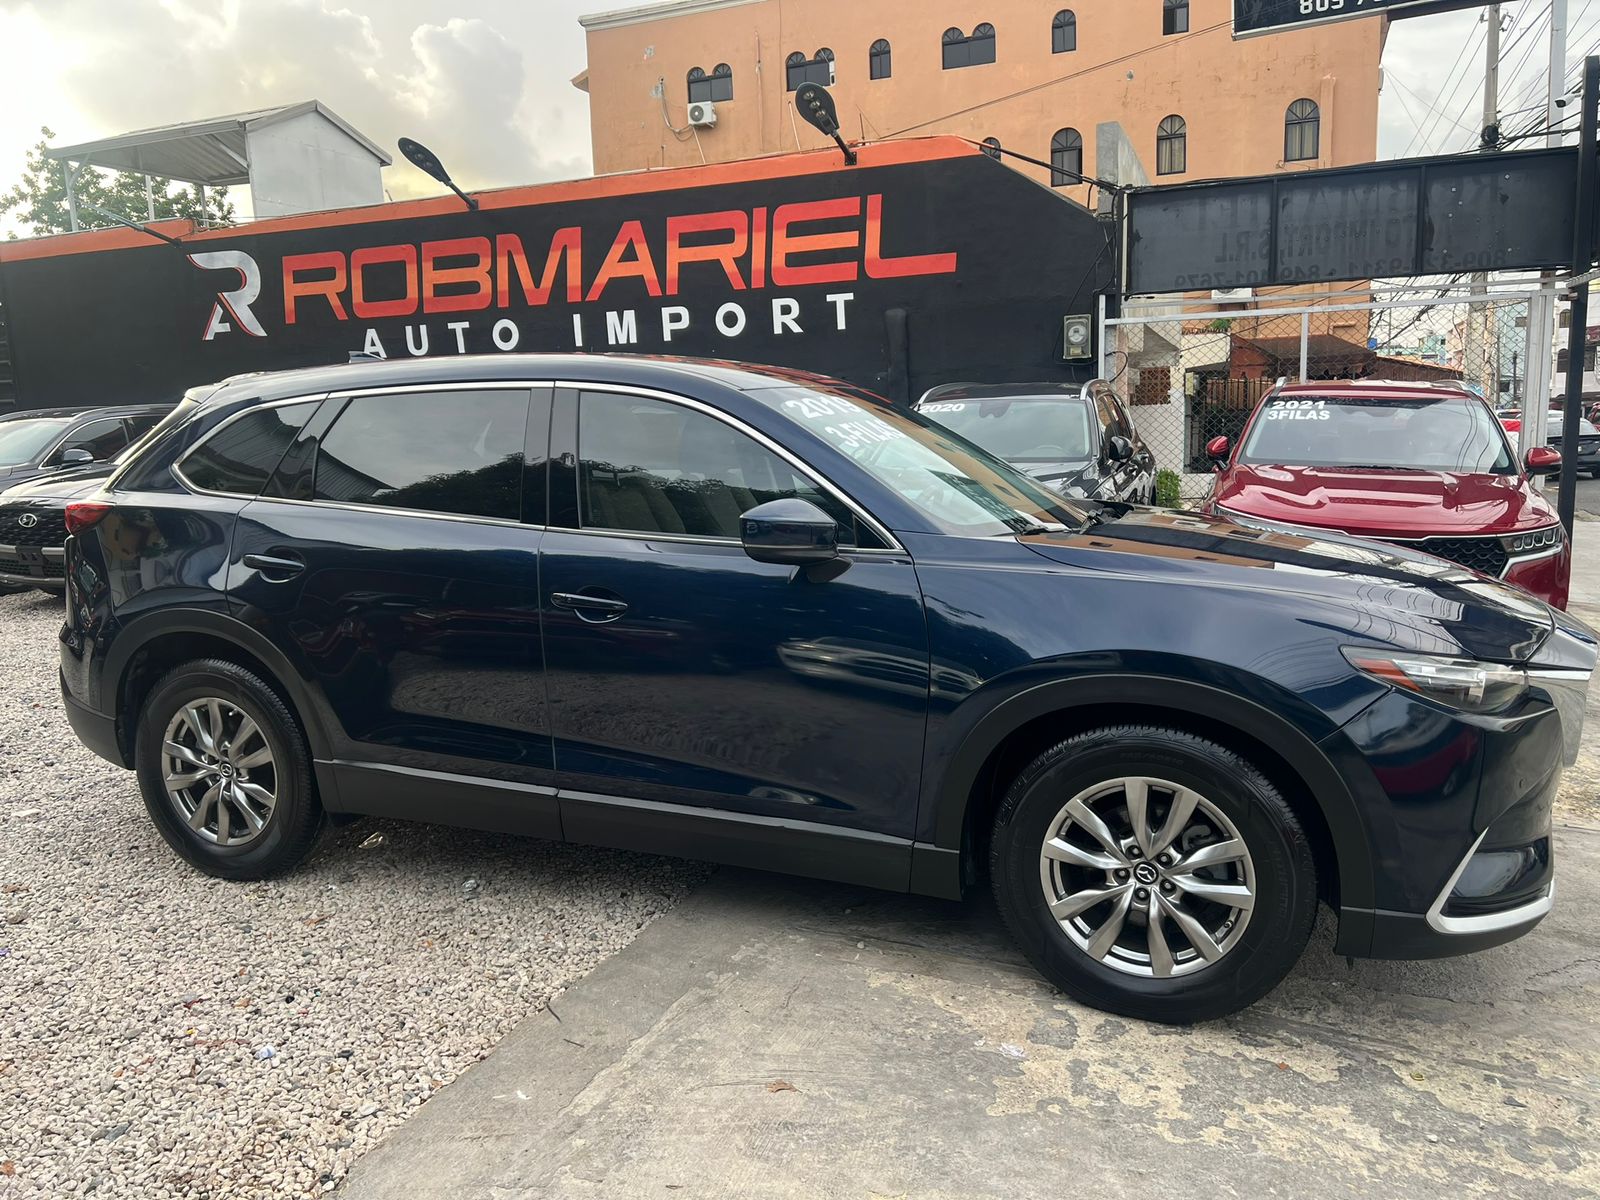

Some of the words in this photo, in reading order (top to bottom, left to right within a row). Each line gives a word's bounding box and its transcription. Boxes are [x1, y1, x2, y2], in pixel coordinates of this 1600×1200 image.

[282, 194, 957, 325] ROBMARIEL
[363, 318, 520, 360] AUTO
[572, 292, 855, 347] IMPORT
[785, 396, 861, 419] 2019
[918, 403, 966, 414] 2020
[1271, 400, 1326, 410] 2021
[1267, 410, 1330, 420] 3FILAS
